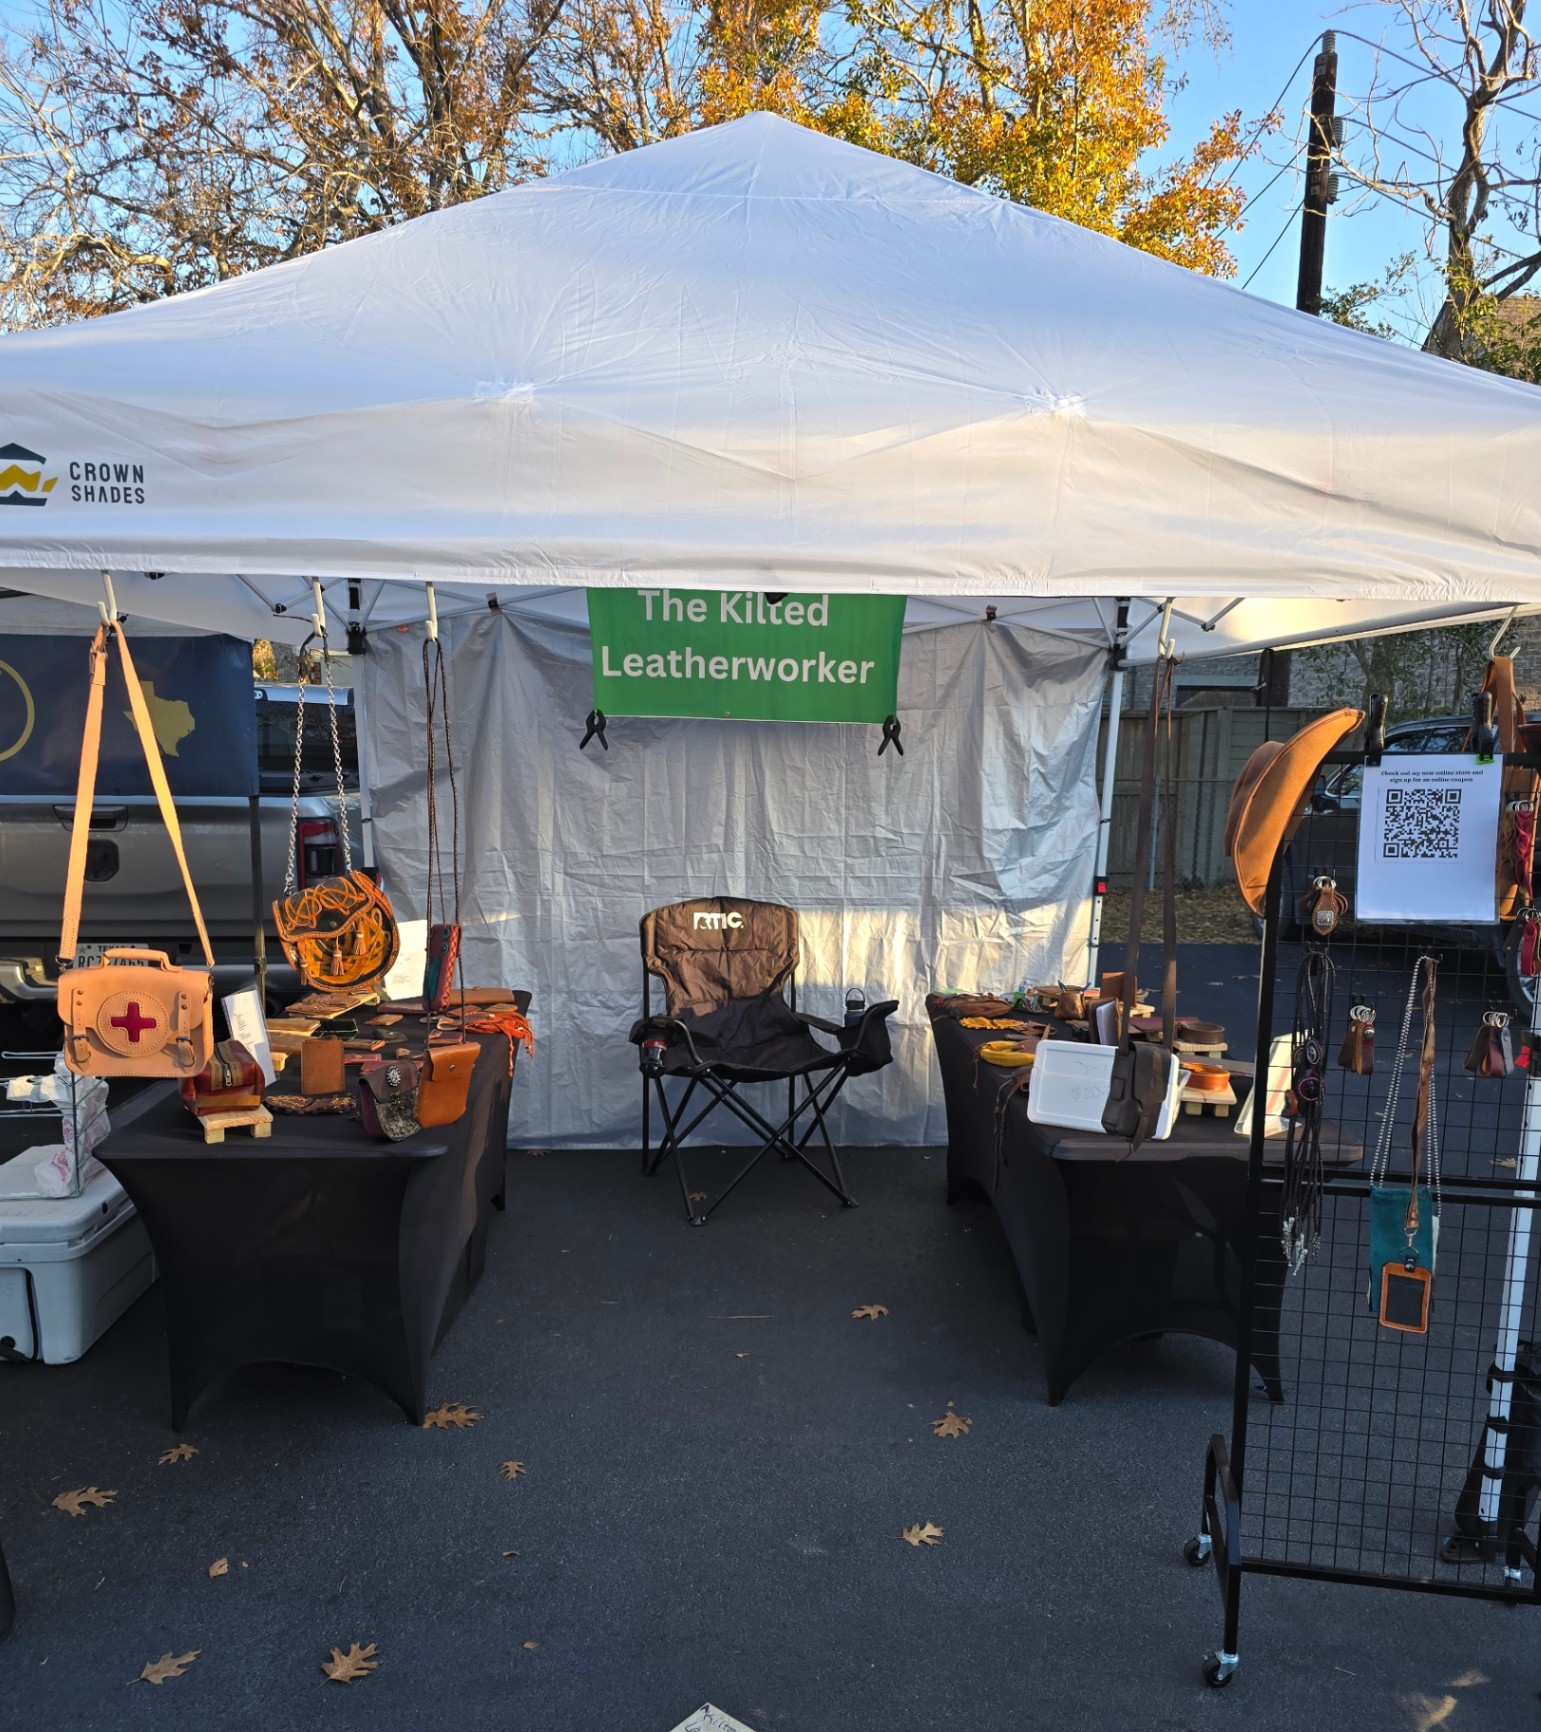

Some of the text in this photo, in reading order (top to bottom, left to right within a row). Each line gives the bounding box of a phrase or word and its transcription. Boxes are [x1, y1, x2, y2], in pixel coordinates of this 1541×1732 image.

[69, 461, 144, 483] CROWN
[71, 485, 145, 504] SHADES
[637, 588, 829, 627] The Kilted
[601, 646, 875, 684] Leatherworker
